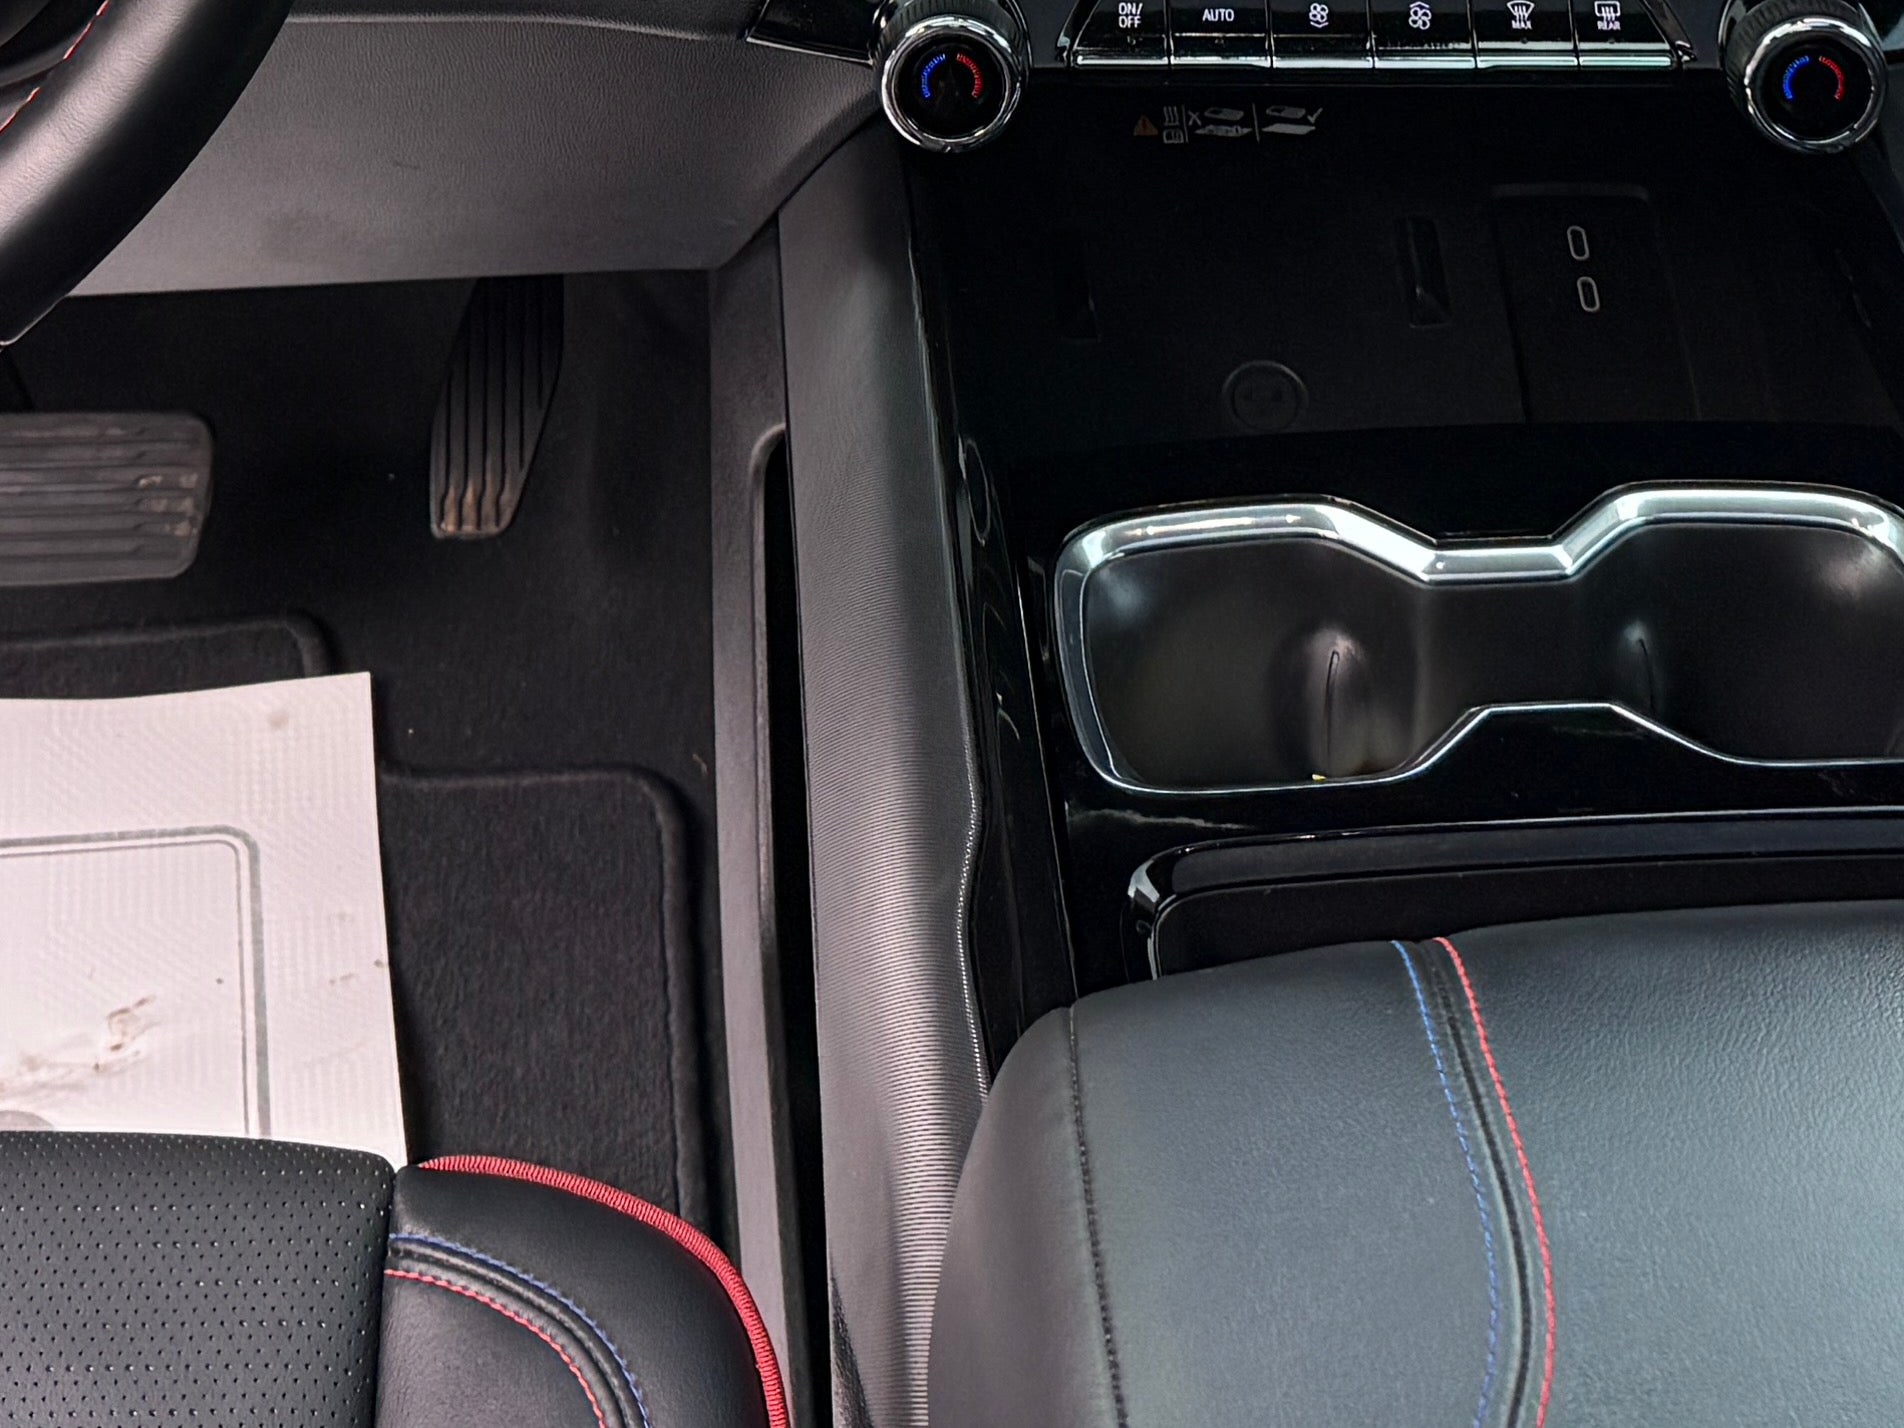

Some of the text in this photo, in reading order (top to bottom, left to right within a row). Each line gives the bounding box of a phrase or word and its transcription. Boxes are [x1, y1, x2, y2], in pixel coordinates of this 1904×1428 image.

[1118, 2, 1144, 16] ON/
[1202, 8, 1235, 22] AUTO
[1118, 16, 1142, 28] OFF
